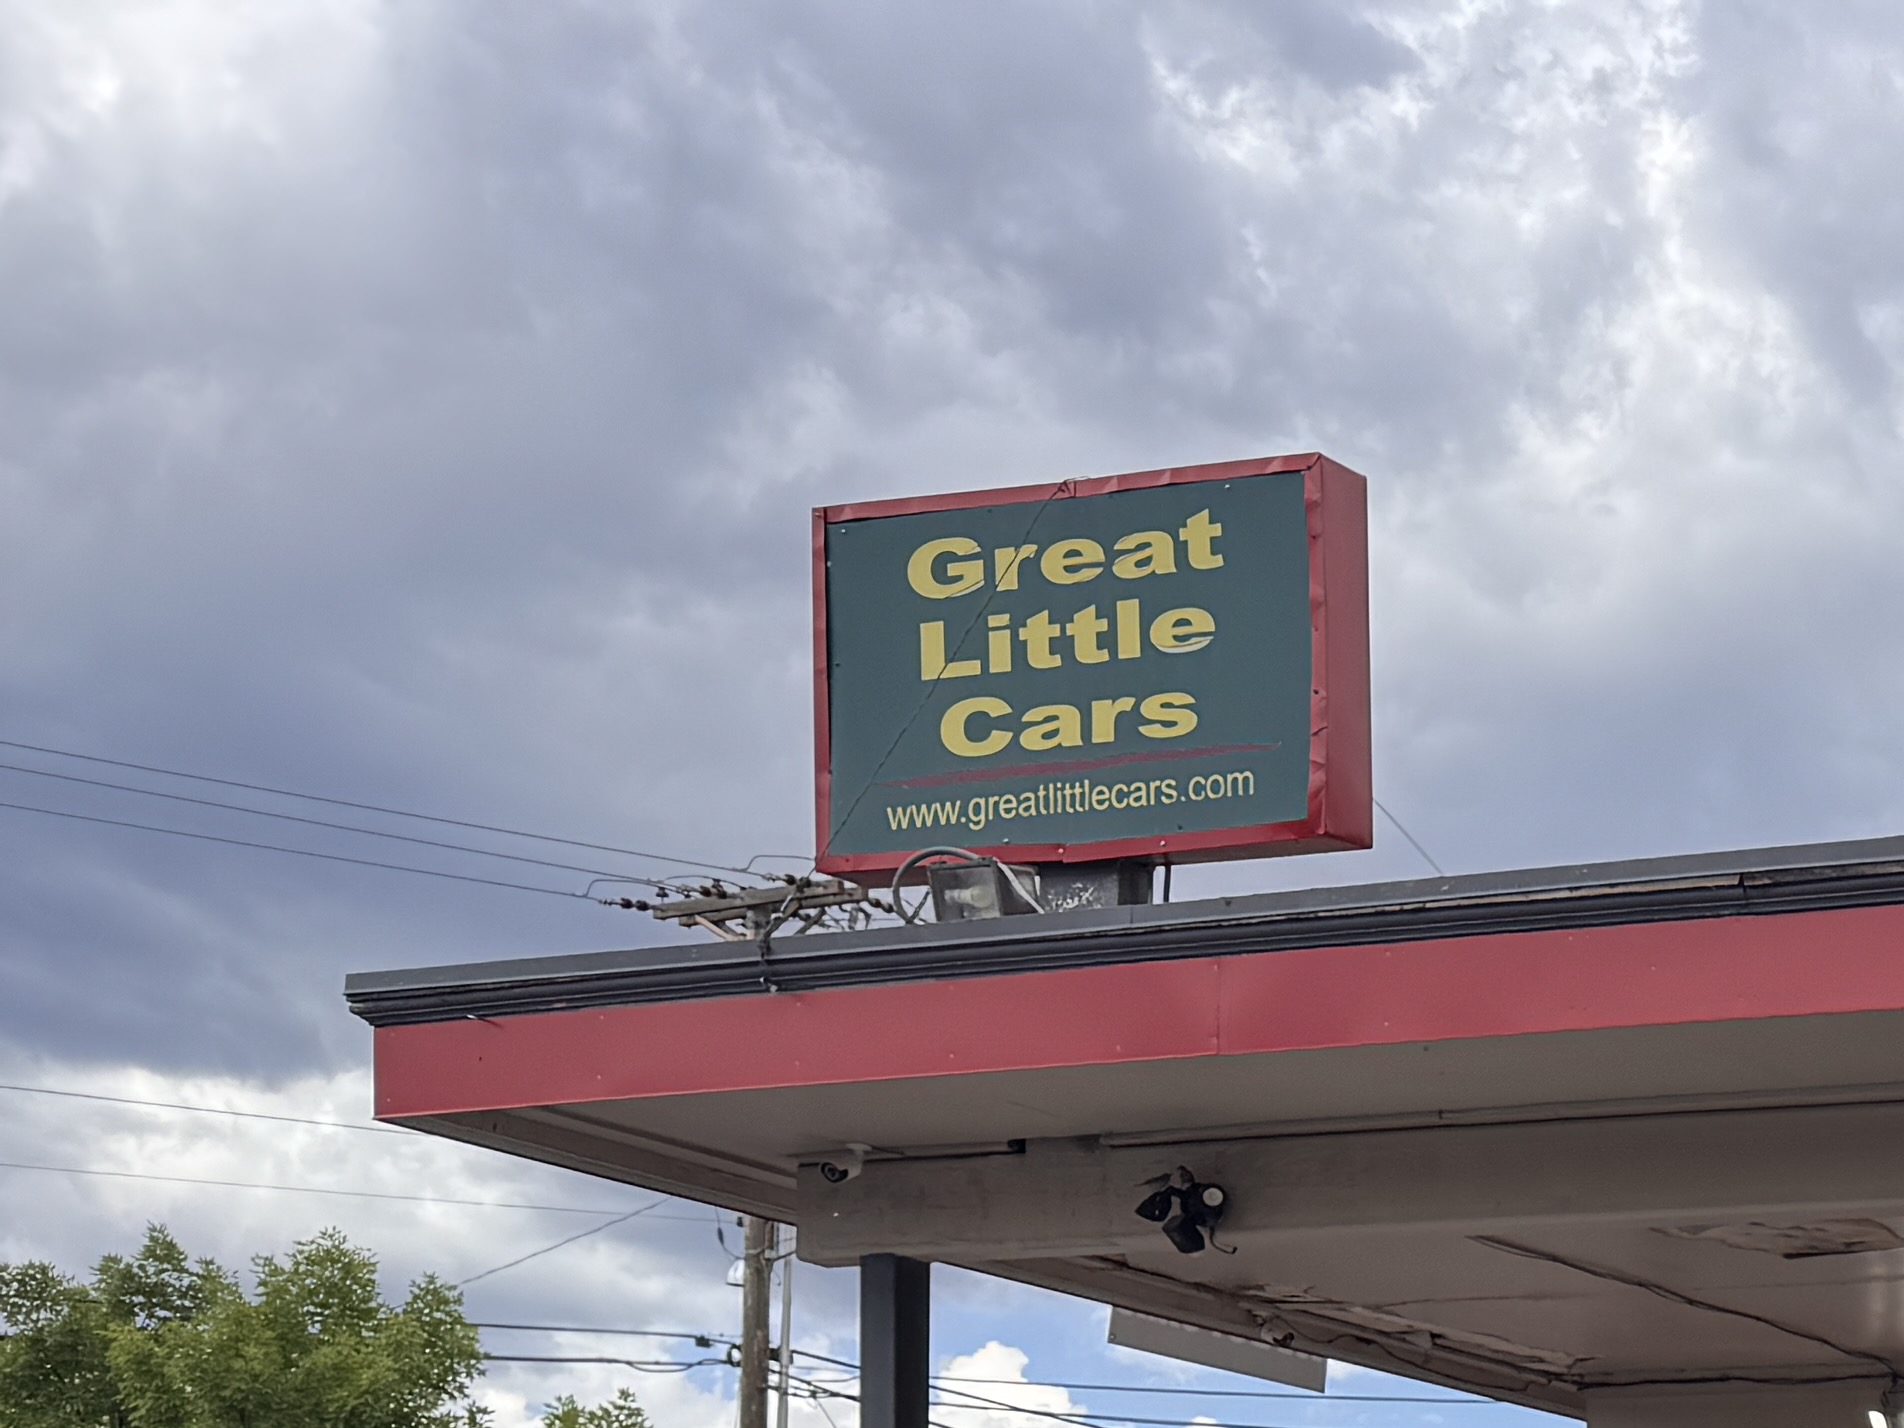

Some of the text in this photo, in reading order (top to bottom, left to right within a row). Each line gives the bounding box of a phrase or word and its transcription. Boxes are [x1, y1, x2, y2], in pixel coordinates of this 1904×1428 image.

[906, 507, 1225, 600] Great
[919, 597, 1217, 682] Little
[939, 691, 1199, 758] Cars
[886, 769, 1255, 832] www.greatlittlecars.com
